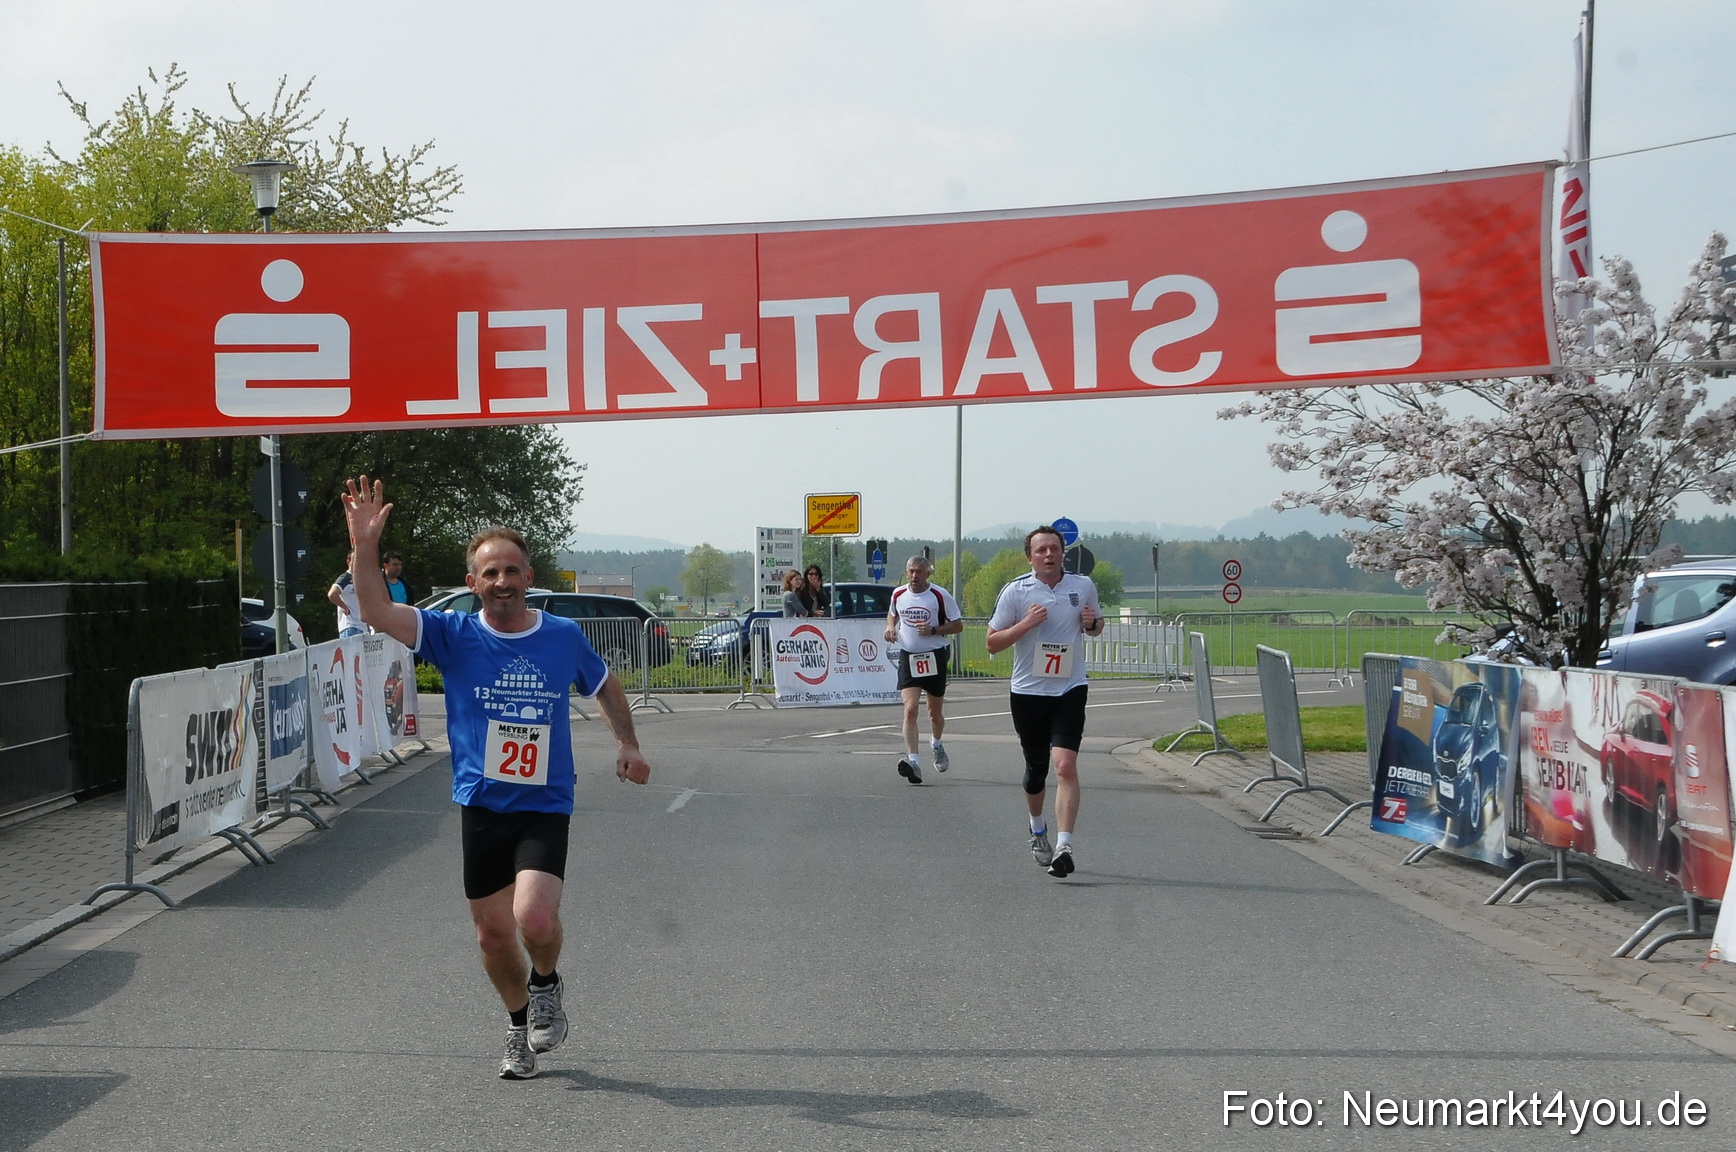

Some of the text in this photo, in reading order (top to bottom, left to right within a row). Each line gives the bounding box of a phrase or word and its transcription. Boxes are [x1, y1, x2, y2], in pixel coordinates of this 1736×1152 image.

[812, 500, 854, 512] Sengenthal
[1226, 565, 1238, 576] 60
[776, 640, 818, 654] GERHART
[862, 645, 875, 657] KIA
[833, 666, 855, 674] SEAT
[916, 660, 930, 675] 81
[473, 686, 494, 700] 13.
[491, 687, 562, 699] Neumarkter Stadtlauf
[778, 693, 801, 703] eumarkt
[498, 724, 528, 735] MEYER
[498, 731, 528, 740] WERBUNG
[499, 740, 539, 778] 29
